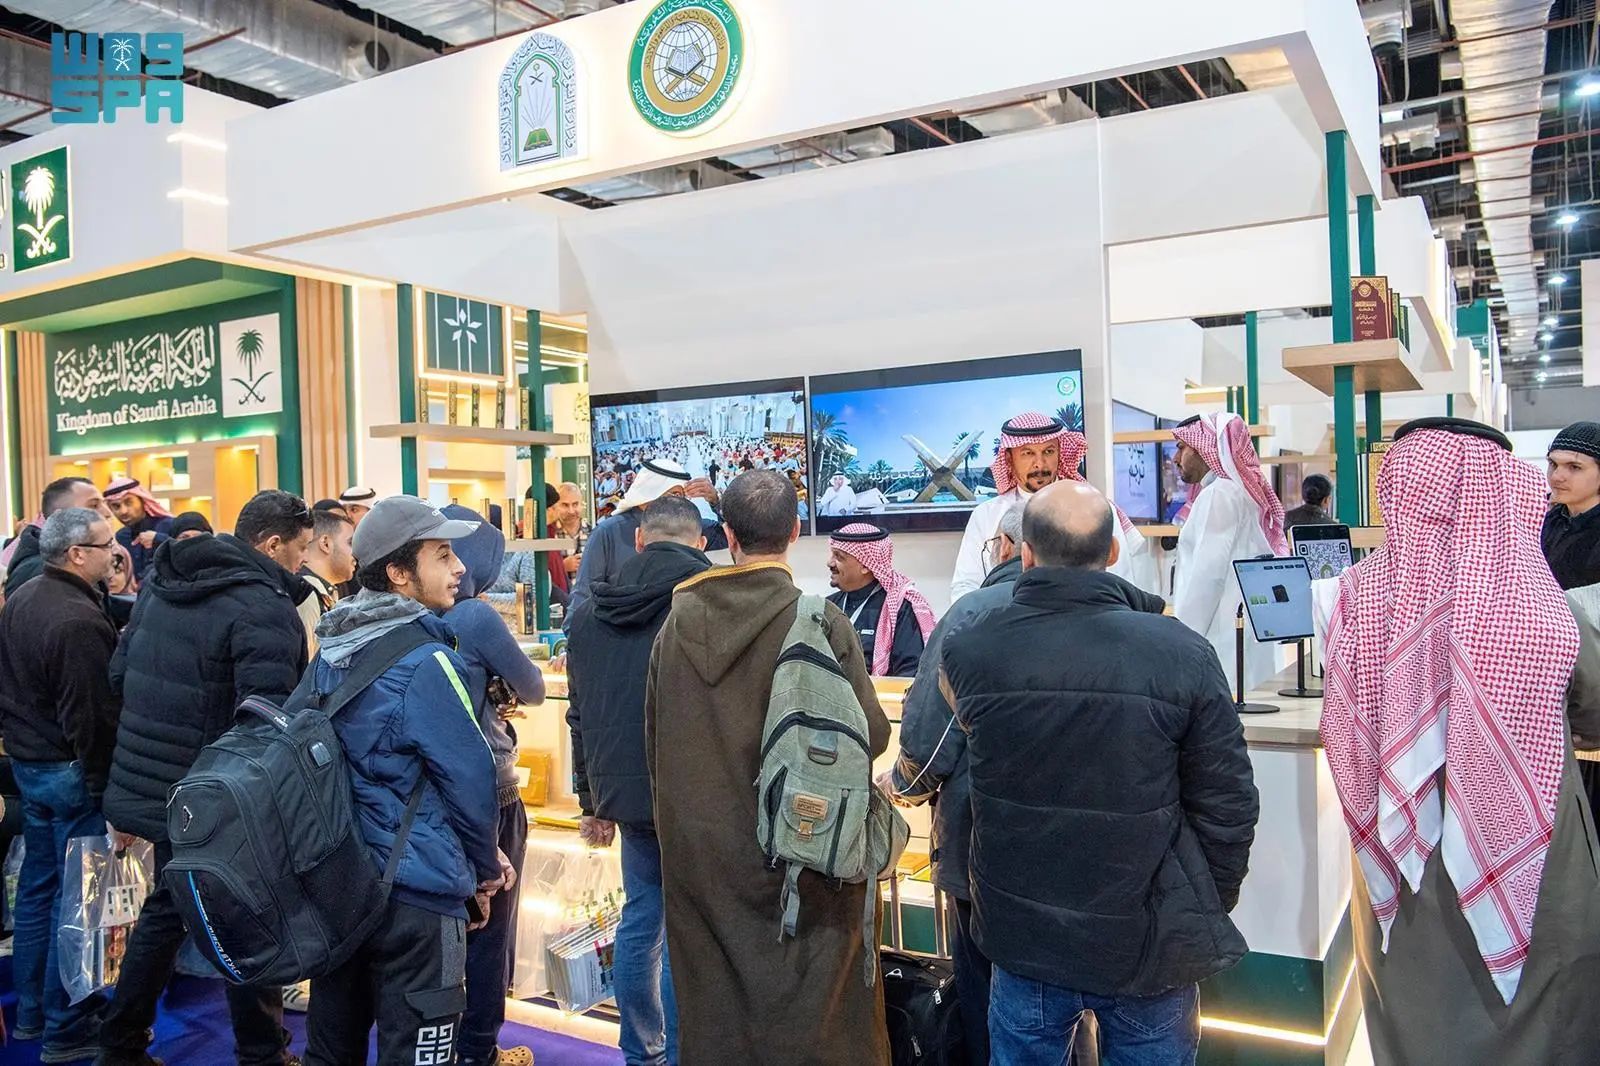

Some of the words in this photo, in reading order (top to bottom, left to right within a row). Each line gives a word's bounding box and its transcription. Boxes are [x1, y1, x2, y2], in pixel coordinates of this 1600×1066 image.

[56, 409, 113, 435] Kingdom
[113, 404, 128, 425] of
[129, 399, 169, 423] Saudi
[170, 394, 217, 418] Arabia
